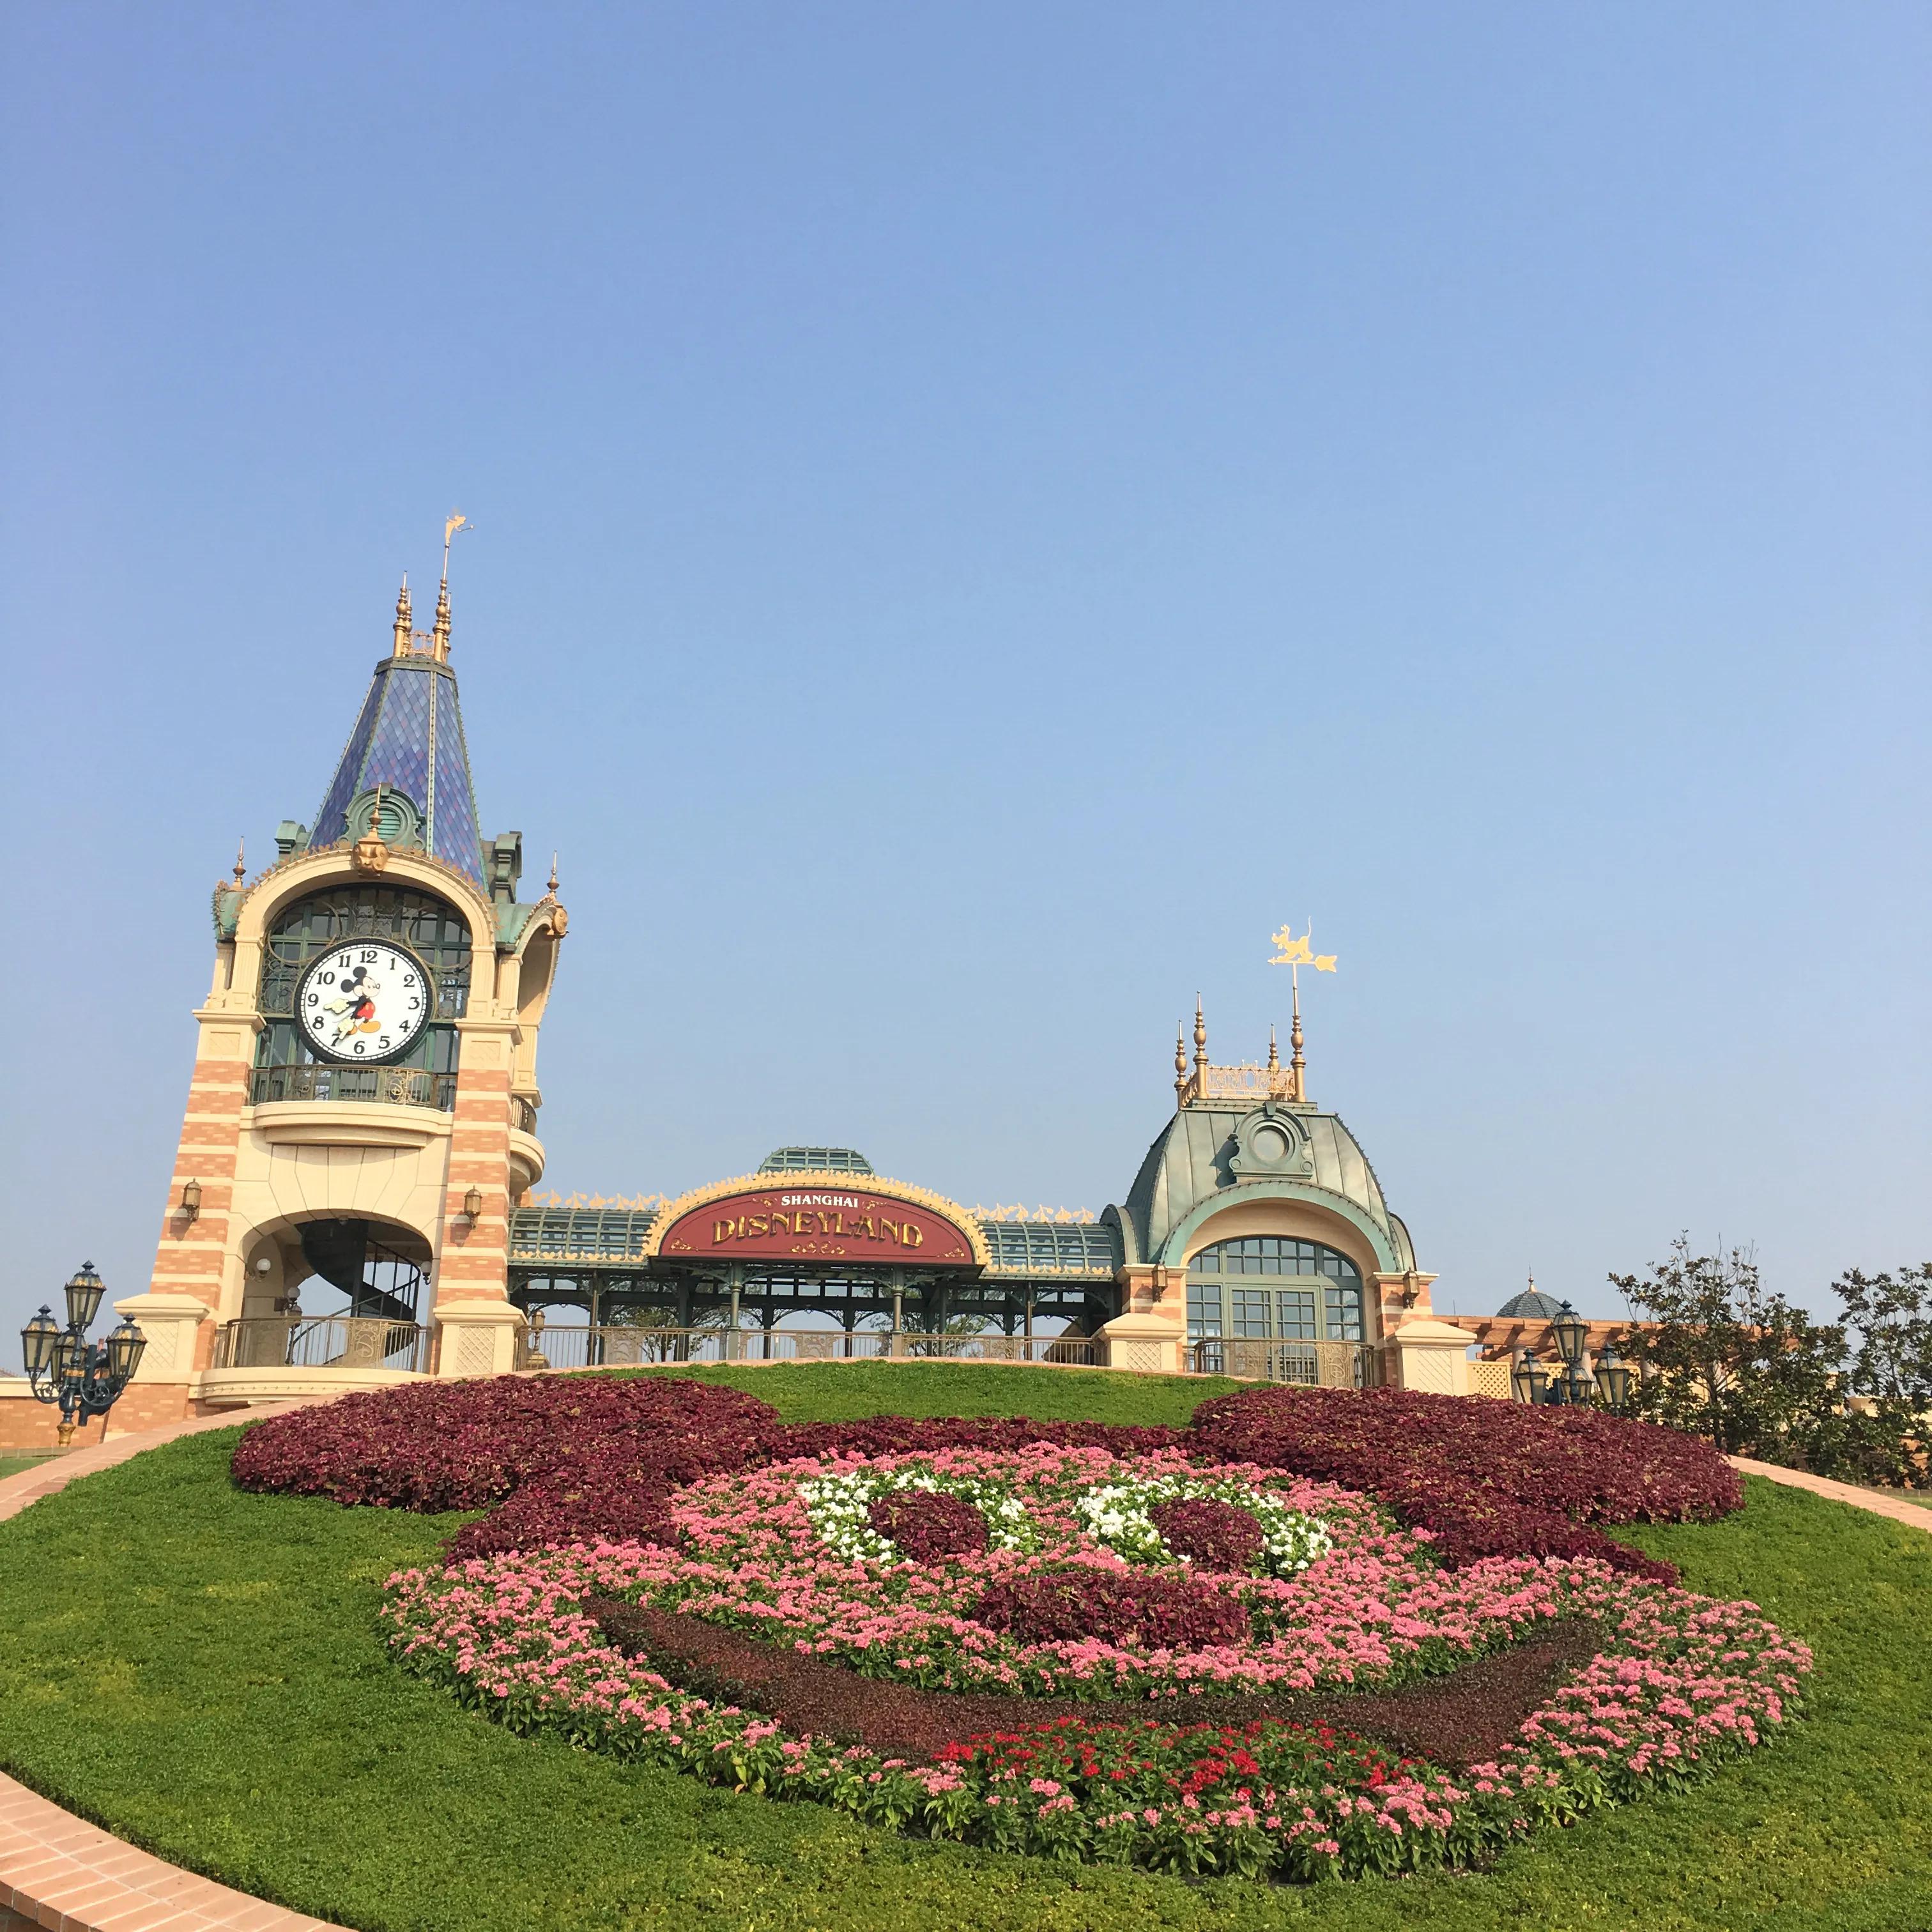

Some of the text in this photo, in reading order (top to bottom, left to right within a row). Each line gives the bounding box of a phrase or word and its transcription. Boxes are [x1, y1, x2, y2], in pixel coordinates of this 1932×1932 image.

[339, 954, 351, 967] 11
[360, 950, 378, 963] 12
[390, 958, 395, 970] 1
[316, 972, 335, 985] 10
[404, 974, 415, 987] 2
[308, 993, 319, 1006] 9
[408, 997, 420, 1009] 3
[312, 1016, 324, 1029] 8
[399, 1020, 410, 1032] 4
[330, 1034, 340, 1046] 7
[378, 1036, 390, 1048] 5
[354, 1041, 365, 1054] 6
[781, 1195, 859, 1208] SHANGHAI
[712, 1211, 923, 1248] DISNEYLAND
